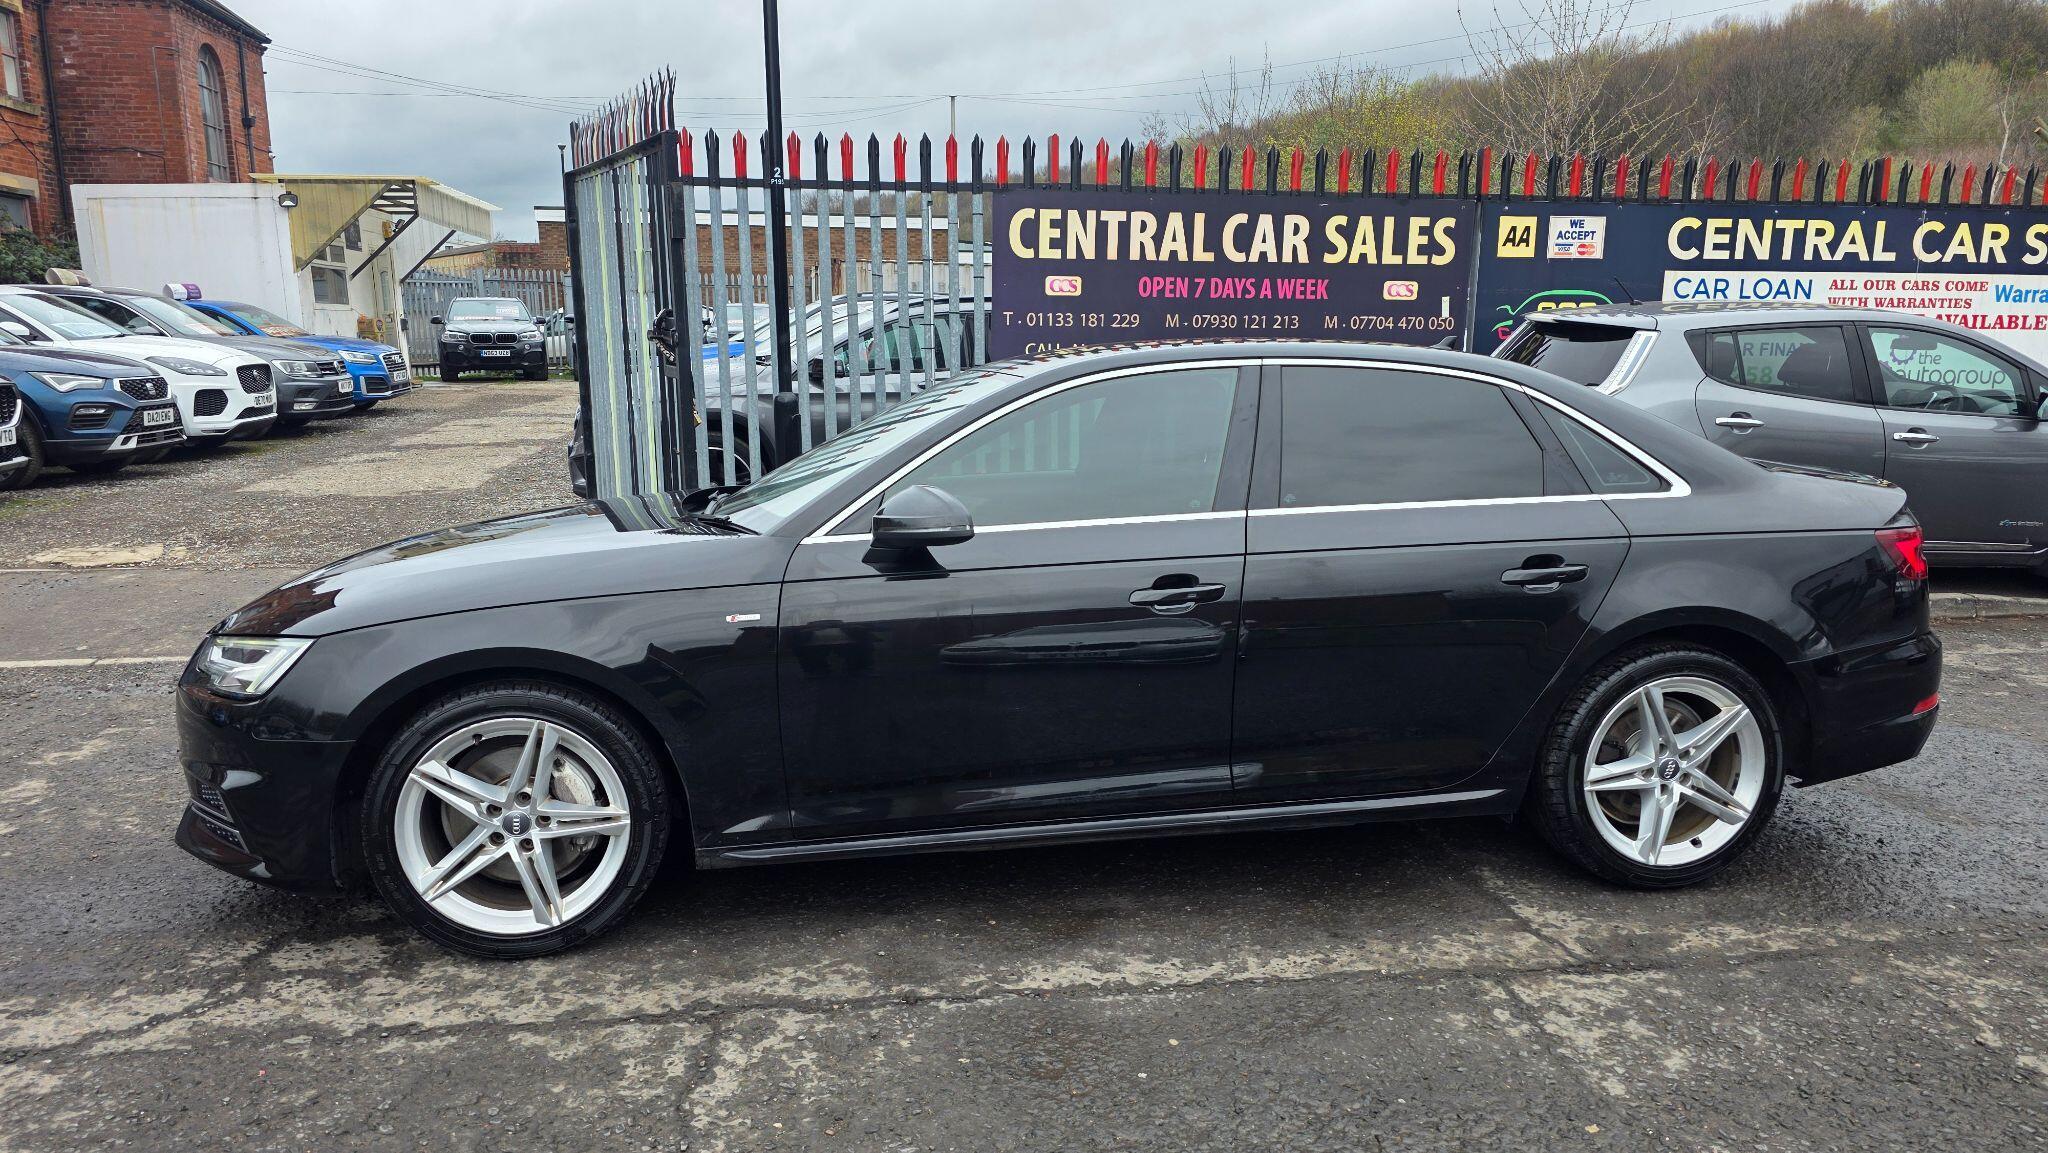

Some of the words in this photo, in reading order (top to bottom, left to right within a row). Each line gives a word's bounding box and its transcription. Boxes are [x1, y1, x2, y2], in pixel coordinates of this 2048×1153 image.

[773, 167, 781, 178] 2
[1569, 219, 1585, 229] WE
[1008, 207, 1215, 262] CENTRAL
[1222, 213, 1310, 264] CAR
[1323, 214, 1457, 266] SALES
[1502, 225, 1531, 248] AA
[1556, 230, 1597, 241] ACCEPT
[1667, 217, 1897, 262] CENTRAL
[1912, 220, 2010, 264] CAR
[2021, 223, 2048, 265] S
[1138, 276, 1189, 298] OPEN
[1194, 277, 1206, 299] 7
[1210, 278, 1256, 299] DAYS
[1258, 278, 1274, 299] A
[1276, 279, 1328, 300] WEEK
[1673, 277, 1730, 300] CAR
[1739, 278, 1813, 300] LOAN
[1829, 279, 1858, 291] ALL
[1863, 279, 1896, 291] OUR
[1901, 280, 1940, 292] CARS
[1945, 281, 1989, 292] COME
[1828, 297, 1869, 309] WITH
[1874, 297, 1973, 309] WARRANTIES
[1026, 312, 1074, 327] 01133
[1081, 313, 1105, 327] 181
[1110, 313, 1140, 328] 229
[1192, 313, 1238, 329] 07930
[1243, 313, 1268, 329] 121
[1273, 314, 1300, 330] 213
[1349, 315, 1394, 330] 07704
[1398, 315, 1425, 331] 470
[1428, 316, 1455, 331] 050
[1759, 342, 1801, 357] FINA
[1918, 350, 1942, 364] the
